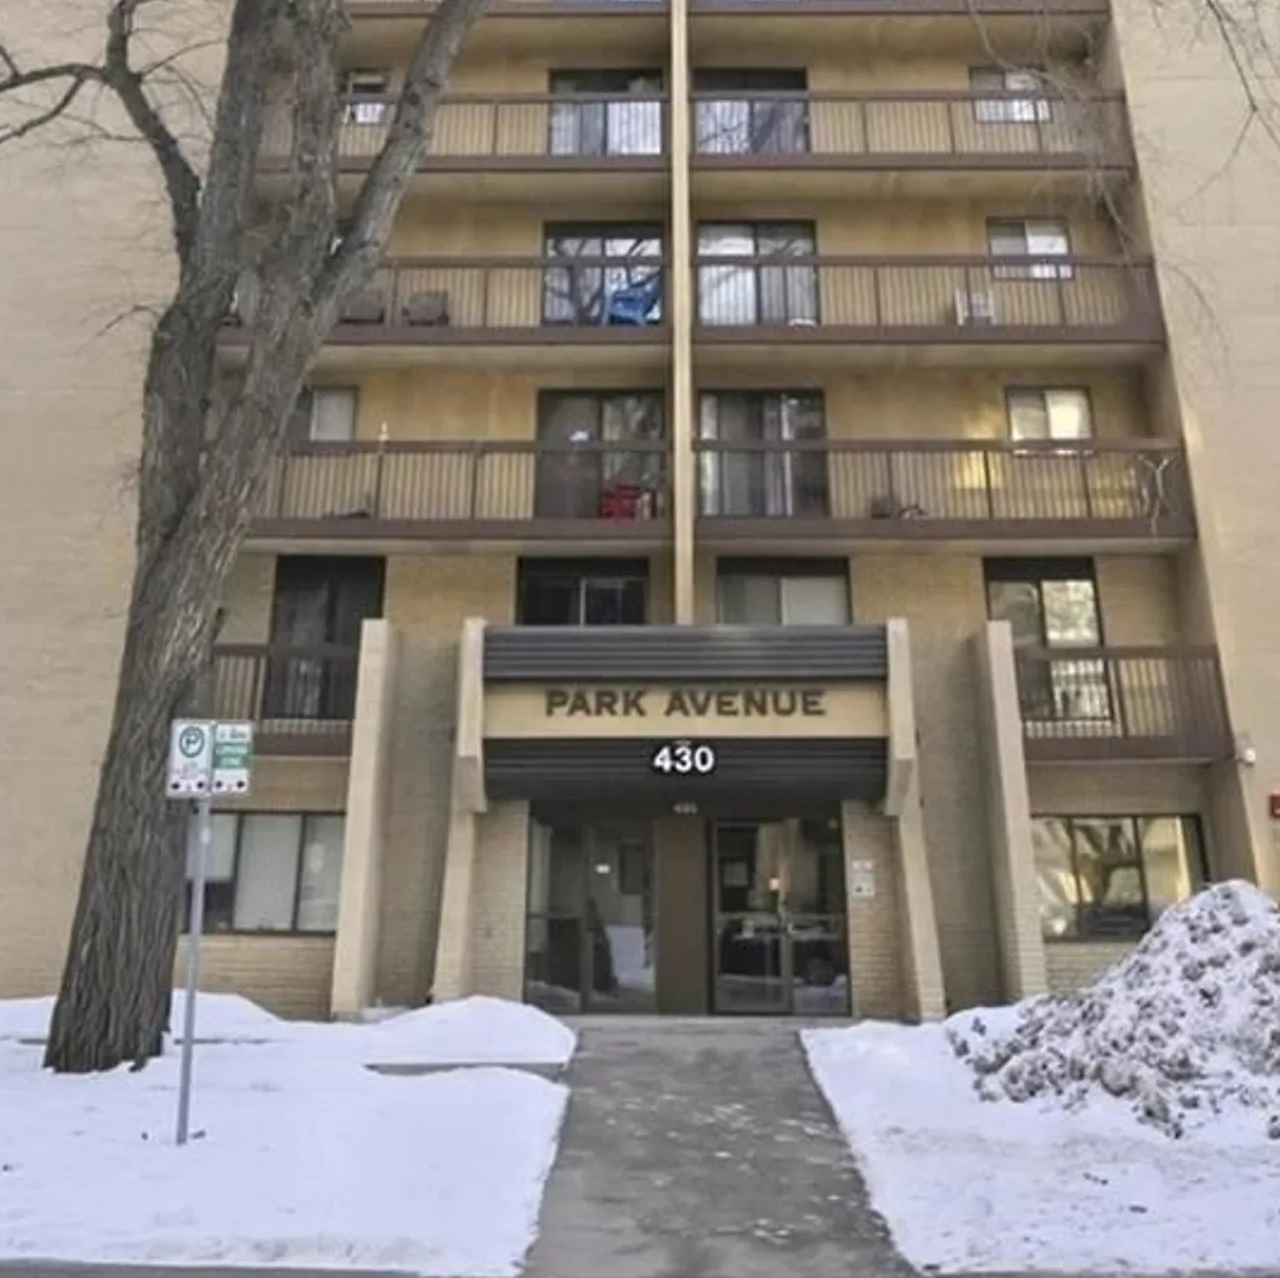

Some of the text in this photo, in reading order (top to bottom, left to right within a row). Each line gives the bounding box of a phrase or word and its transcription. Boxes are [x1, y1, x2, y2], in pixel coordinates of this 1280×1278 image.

[545, 689, 827, 717] PARK AVENUE
[653, 746, 715, 772] 430
